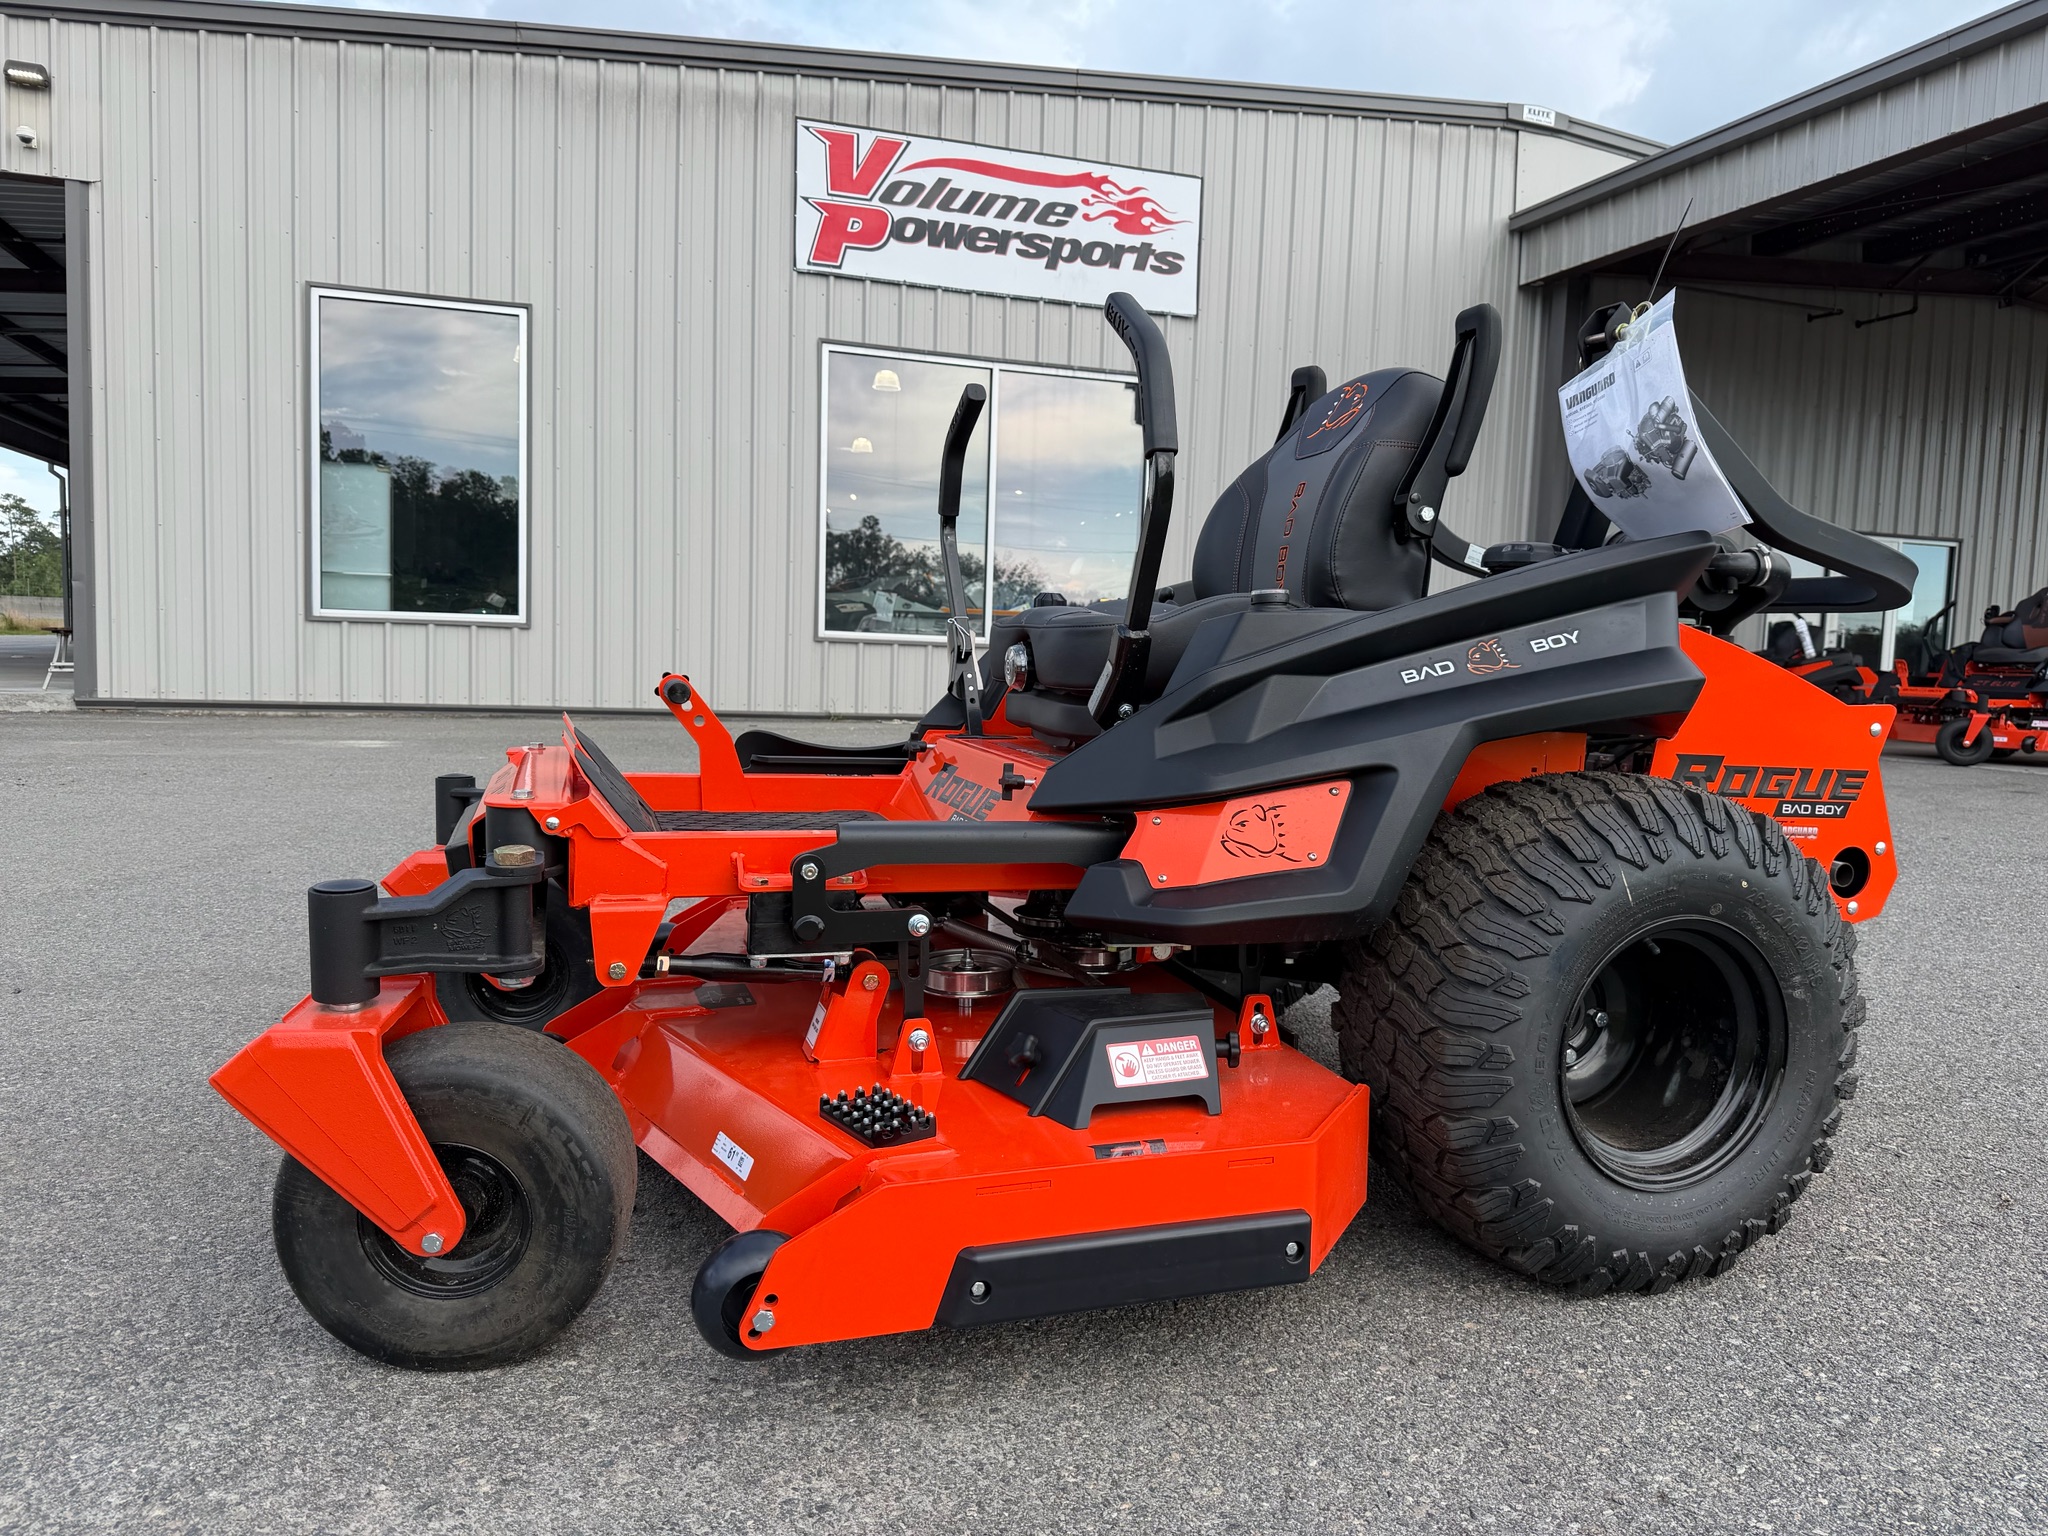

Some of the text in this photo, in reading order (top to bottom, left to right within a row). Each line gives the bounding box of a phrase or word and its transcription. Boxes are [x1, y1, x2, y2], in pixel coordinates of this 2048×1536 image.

[1528, 108, 1552, 118] ELITE
[801, 124, 1079, 229] Volume
[800, 196, 1186, 275] Powersports
[1565, 371, 1616, 410] VANGUARD
[1283, 481, 1307, 537] BAD
[1400, 630, 1579, 684] BAD BOY
[924, 763, 1002, 821] ROGUE
[1672, 753, 1869, 801] ROGUE
[1782, 803, 1844, 815] BAD BOY
[1156, 1040, 1197, 1053] DANGER
[1745, 1147, 1784, 1191] TURF
